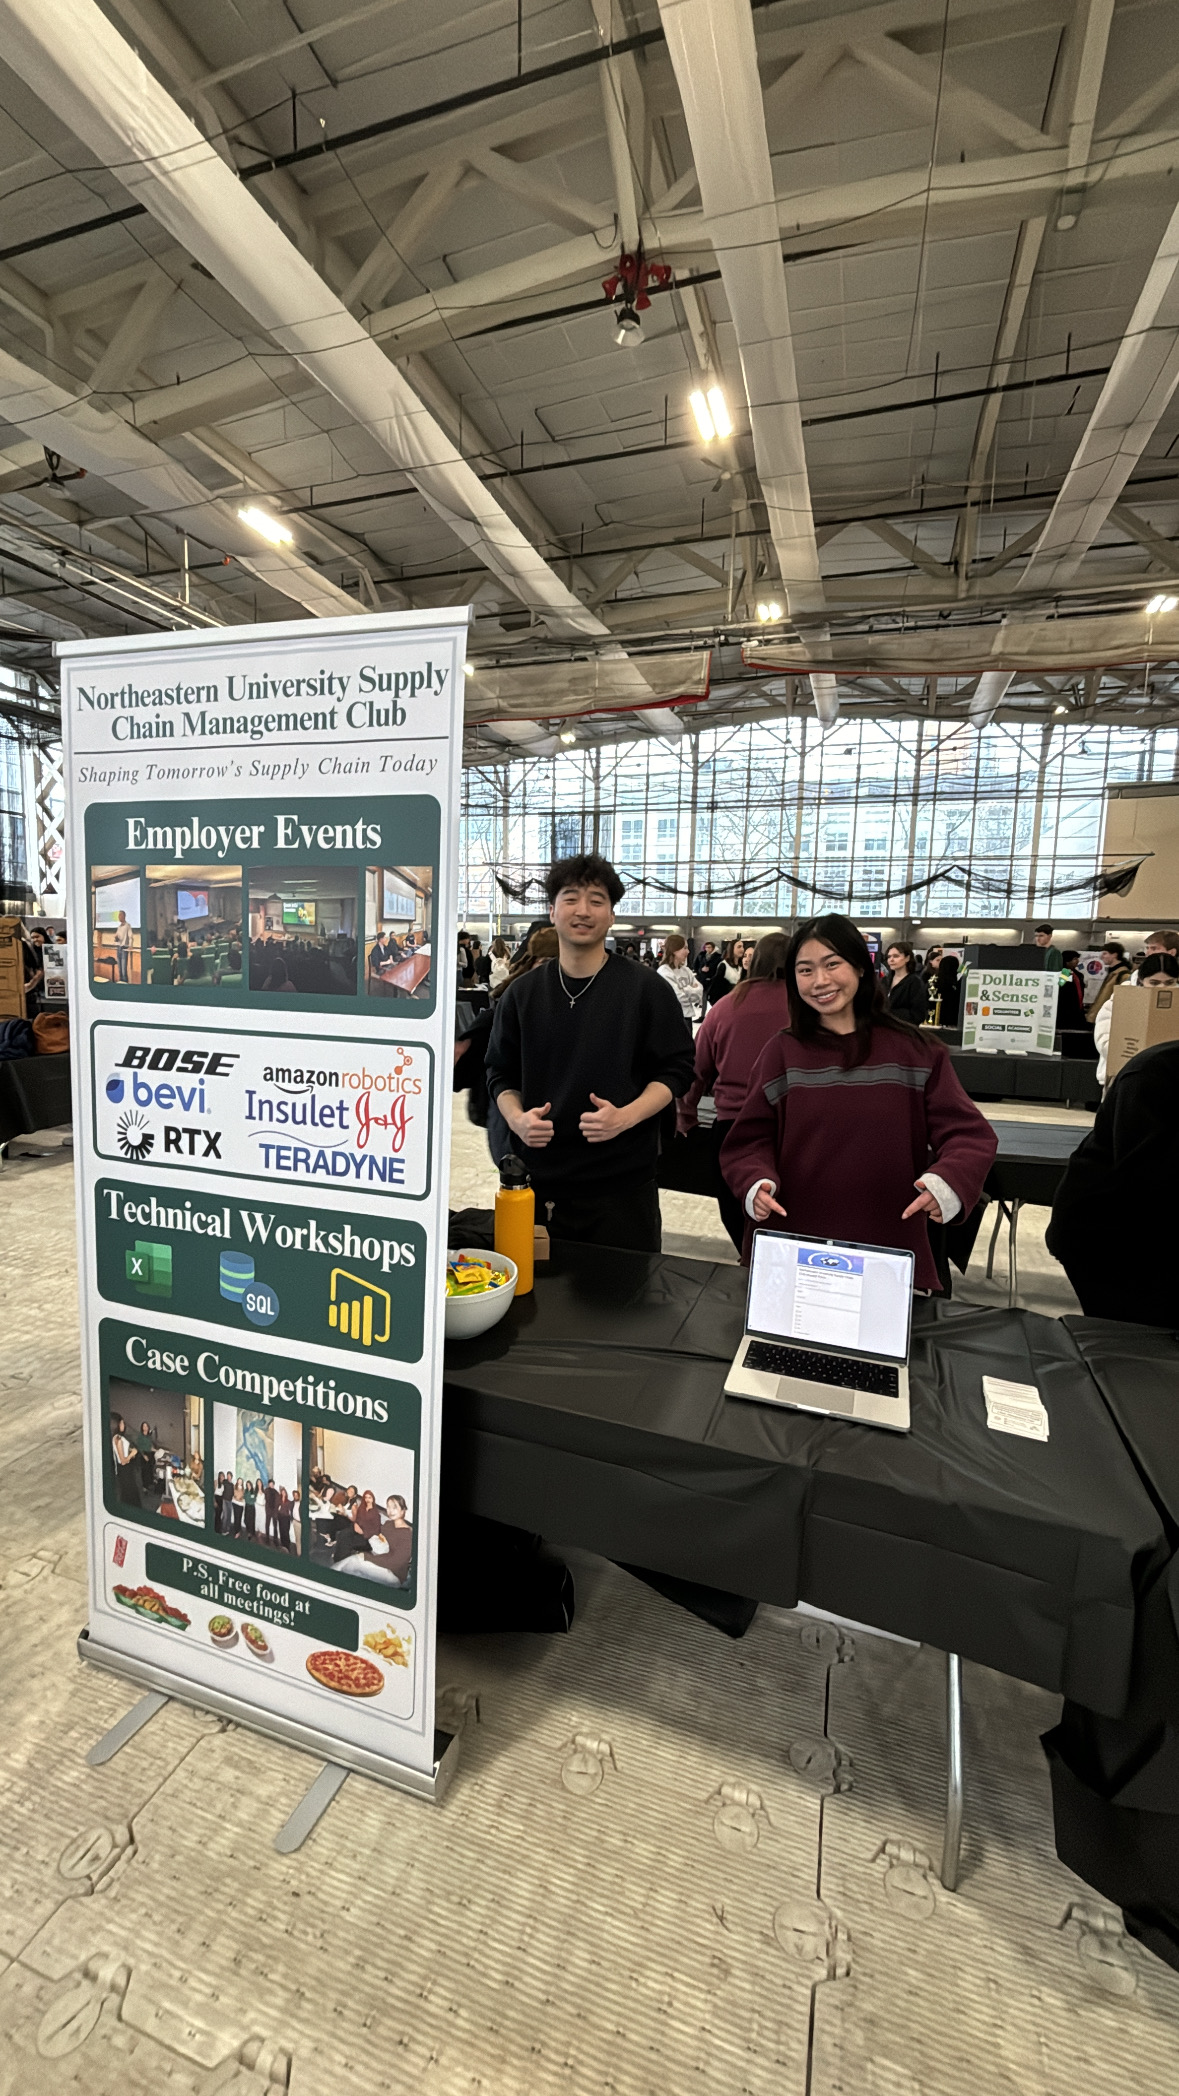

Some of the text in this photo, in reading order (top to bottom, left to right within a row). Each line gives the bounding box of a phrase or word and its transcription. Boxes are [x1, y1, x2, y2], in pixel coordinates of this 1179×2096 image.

[76, 661, 450, 712] Northeastern University Supply
[111, 700, 407, 741] Chain Management Club
[78, 754, 439, 786] Shaping Tomorrow's Supply Chain Today
[125, 814, 382, 859] Employer Events
[981, 974, 1040, 987] Dollars
[114, 1046, 240, 1077] BOSE
[245, 1089, 350, 1130] Insulet
[164, 1126, 222, 1159] RTX
[258, 1142, 406, 1184] TERADYNE
[103, 1188, 416, 1273] Technical Workshops
[246, 1294, 275, 1315] SQL
[125, 1336, 389, 1423] Case Competitions
[182, 1557, 311, 1615] P.S. Free food at
[200, 1582, 296, 1627] all meetings!
